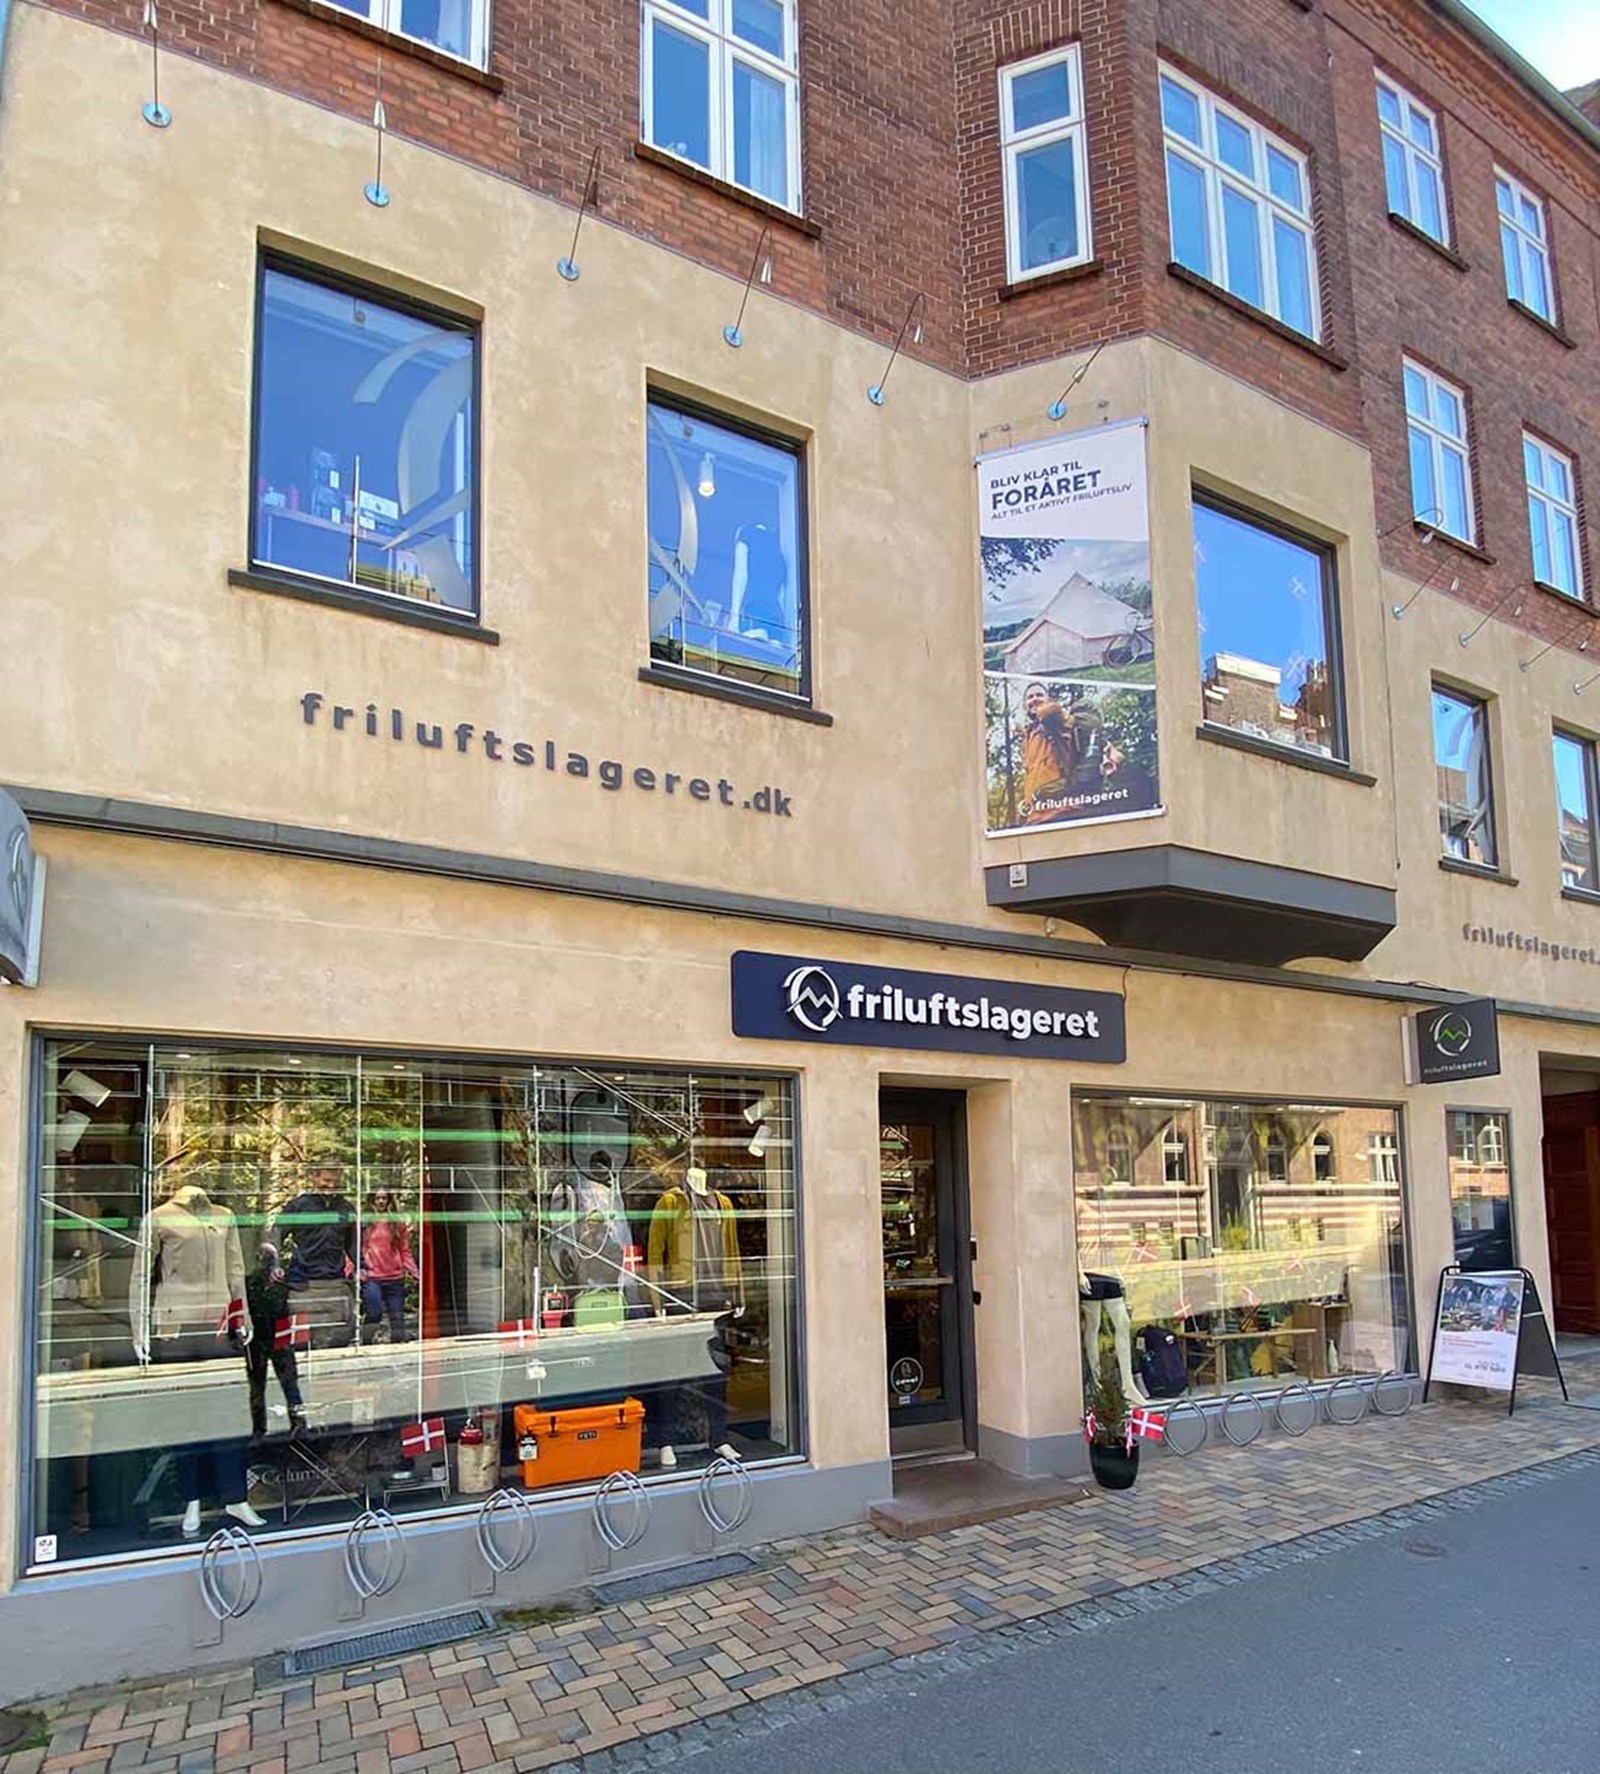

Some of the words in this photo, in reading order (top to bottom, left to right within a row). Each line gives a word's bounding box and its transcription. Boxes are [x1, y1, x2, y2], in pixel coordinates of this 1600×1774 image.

[990, 474, 1020, 489] BLIV
[1023, 465, 1059, 482] KLAR
[1063, 460, 1083, 473] TIL
[991, 470, 1102, 510] FORÅRET
[991, 509, 1008, 520] ALT
[1010, 507, 1024, 517] TIL
[1025, 504, 1036, 514] ET
[1038, 497, 1071, 511] AKTIVT
[1073, 483, 1132, 503] FRILUFTSLIV
[301, 692, 793, 817] friluftslageret.dk
[1035, 788, 1129, 811] friluftslageret
[847, 985, 1100, 1039] friluftslageret
